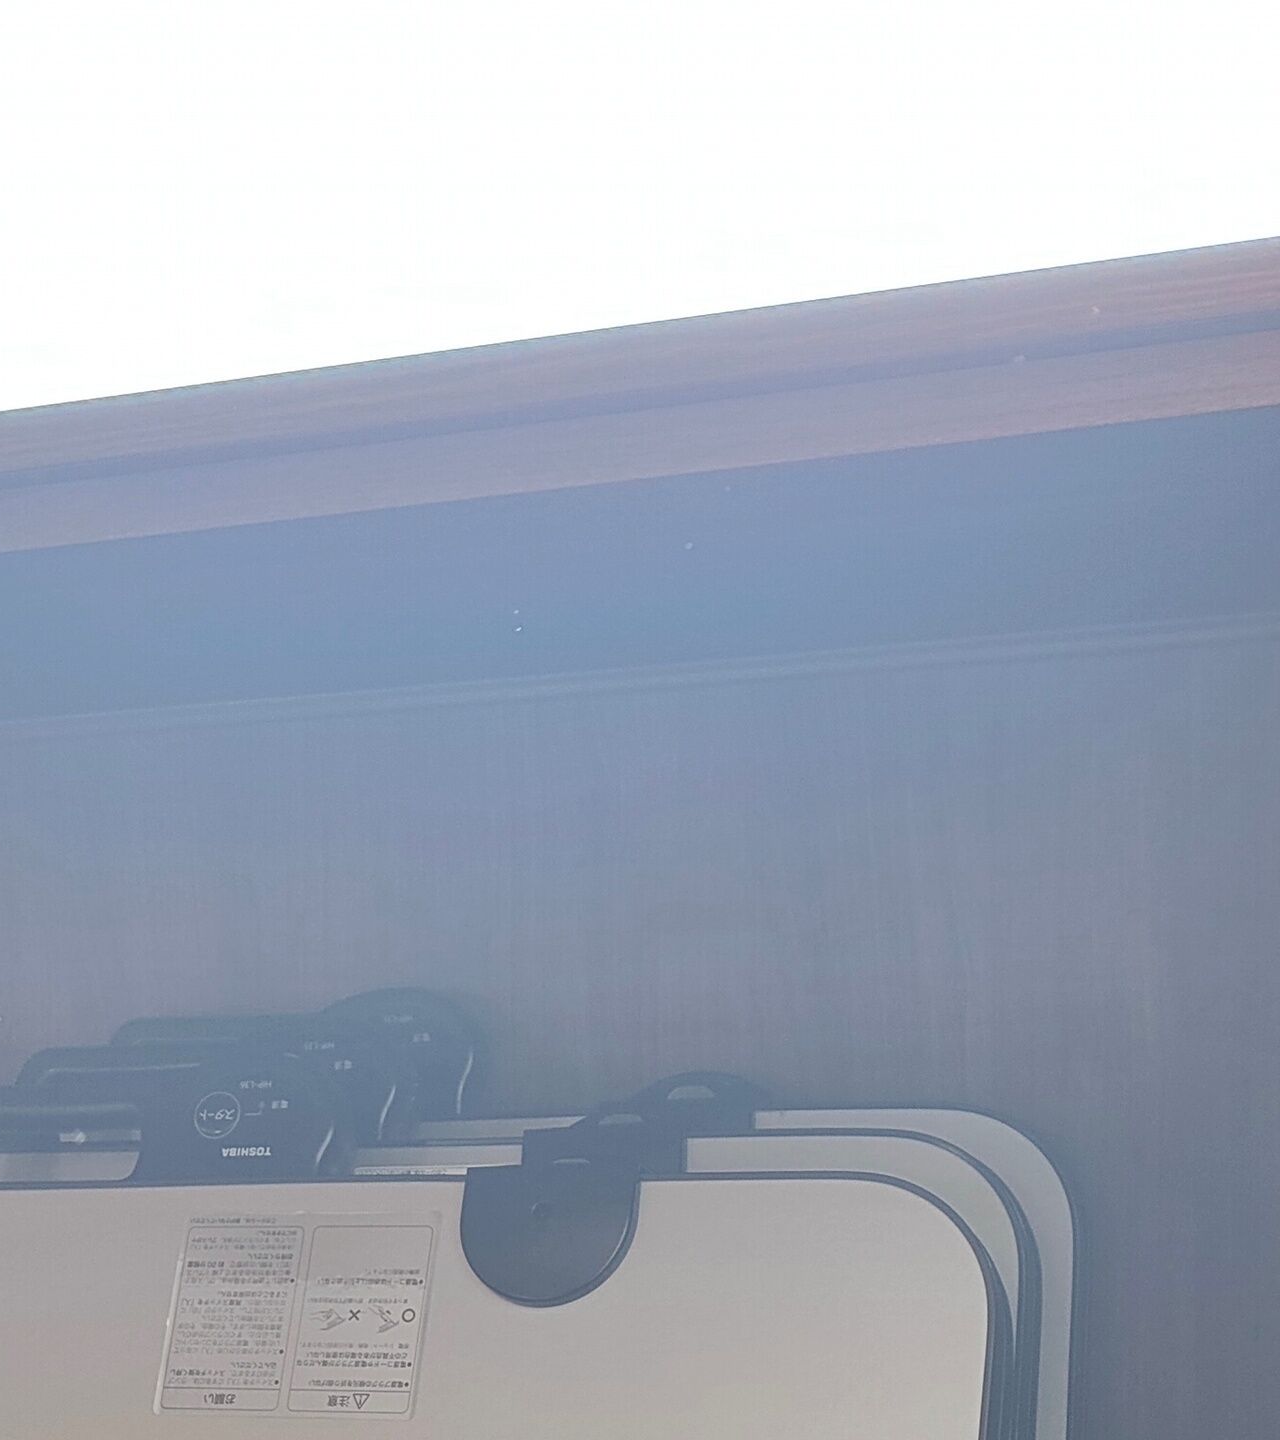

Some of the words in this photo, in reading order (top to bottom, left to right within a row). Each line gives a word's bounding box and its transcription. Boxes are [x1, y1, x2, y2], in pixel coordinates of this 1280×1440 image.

[198, 1107, 236, 1120] スタート
[221, 1146, 272, 1157] TOSHIBA
[203, 1394, 237, 1405] お願い
[327, 1395, 351, 1407] 注意
